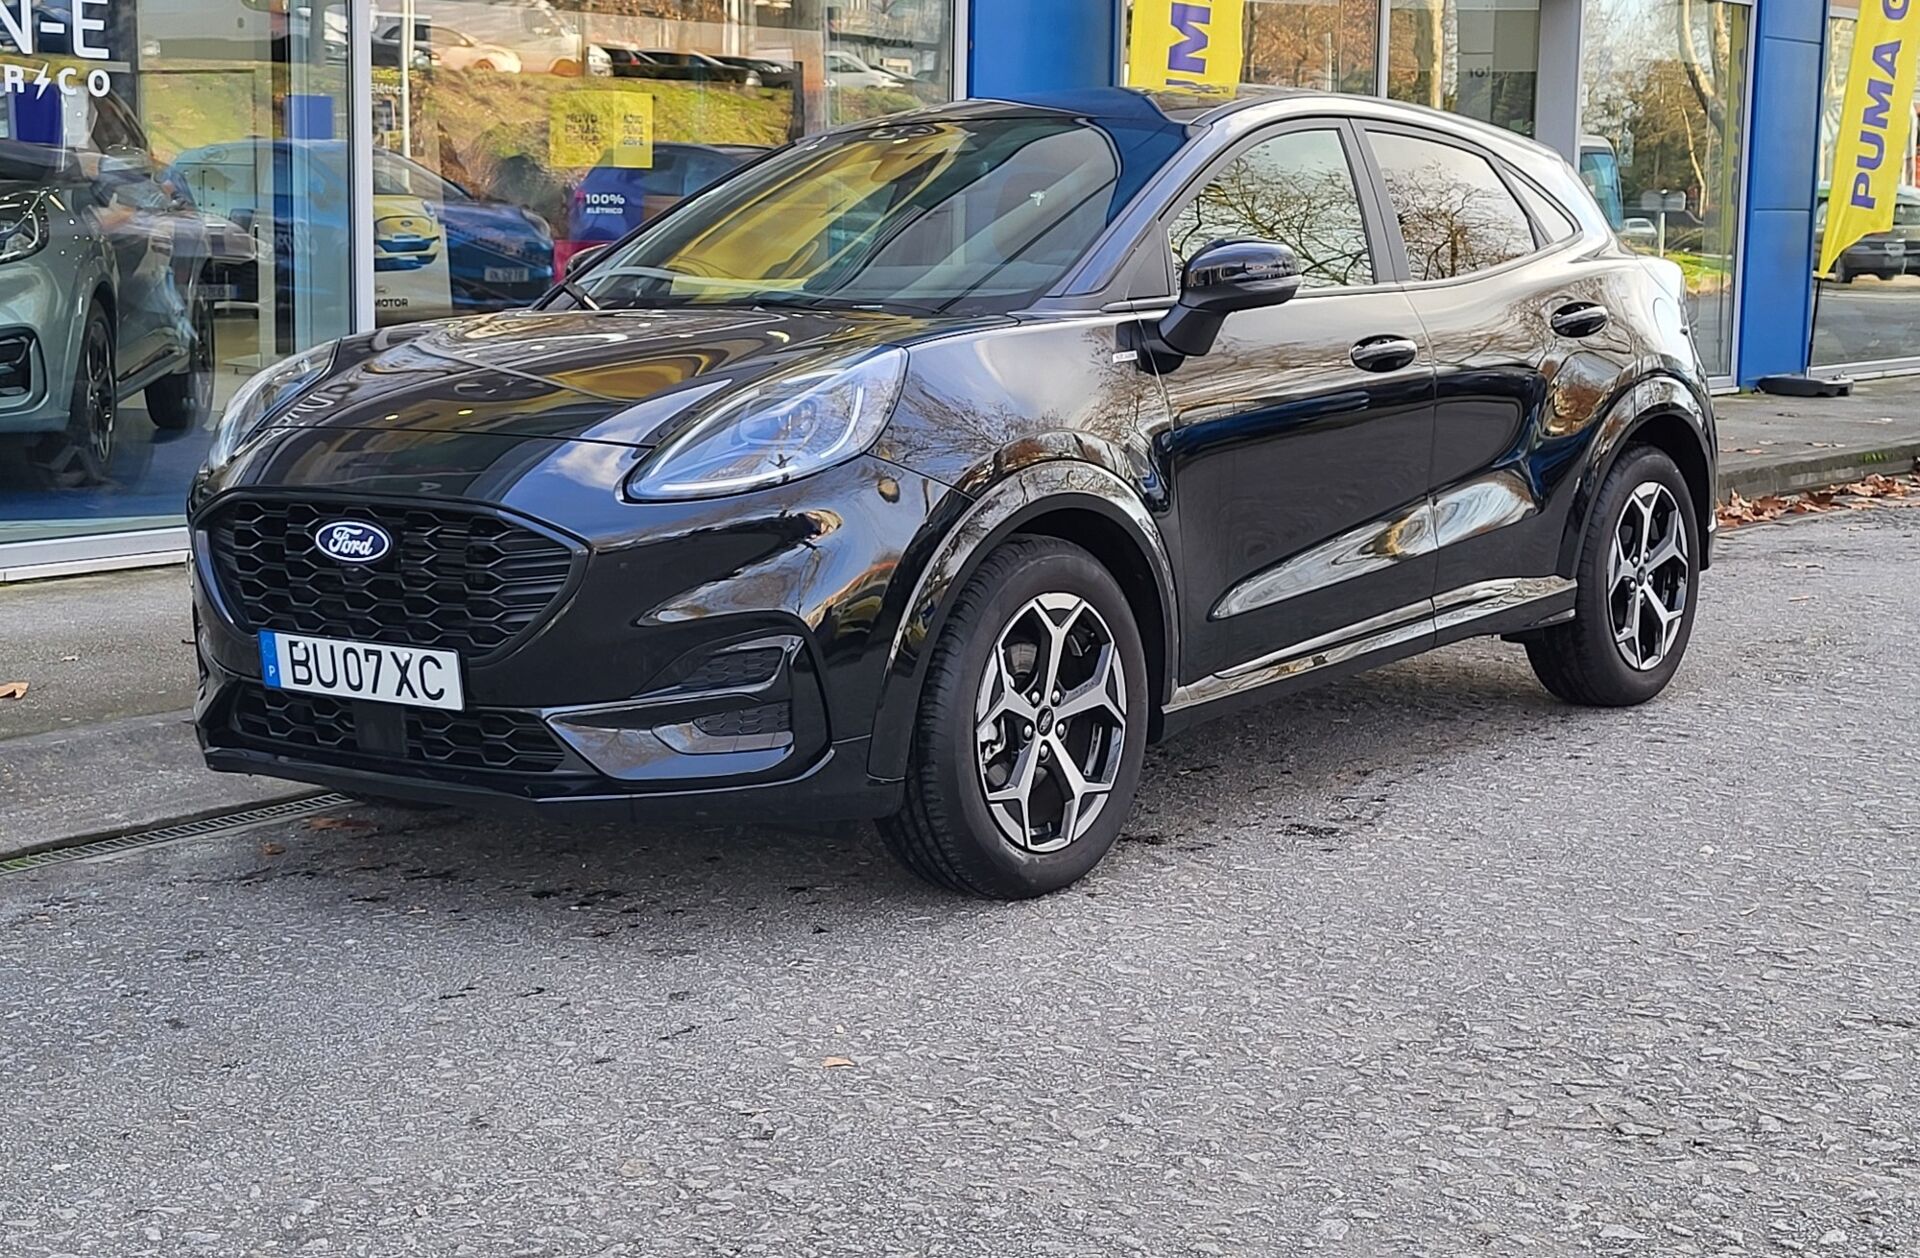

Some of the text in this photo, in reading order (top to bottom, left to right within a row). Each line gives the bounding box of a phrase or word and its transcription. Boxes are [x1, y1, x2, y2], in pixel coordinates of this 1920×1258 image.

[1851, 40, 1902, 209] PUMA
[585, 193, 625, 205] 100%
[328, 527, 374, 555] Ford
